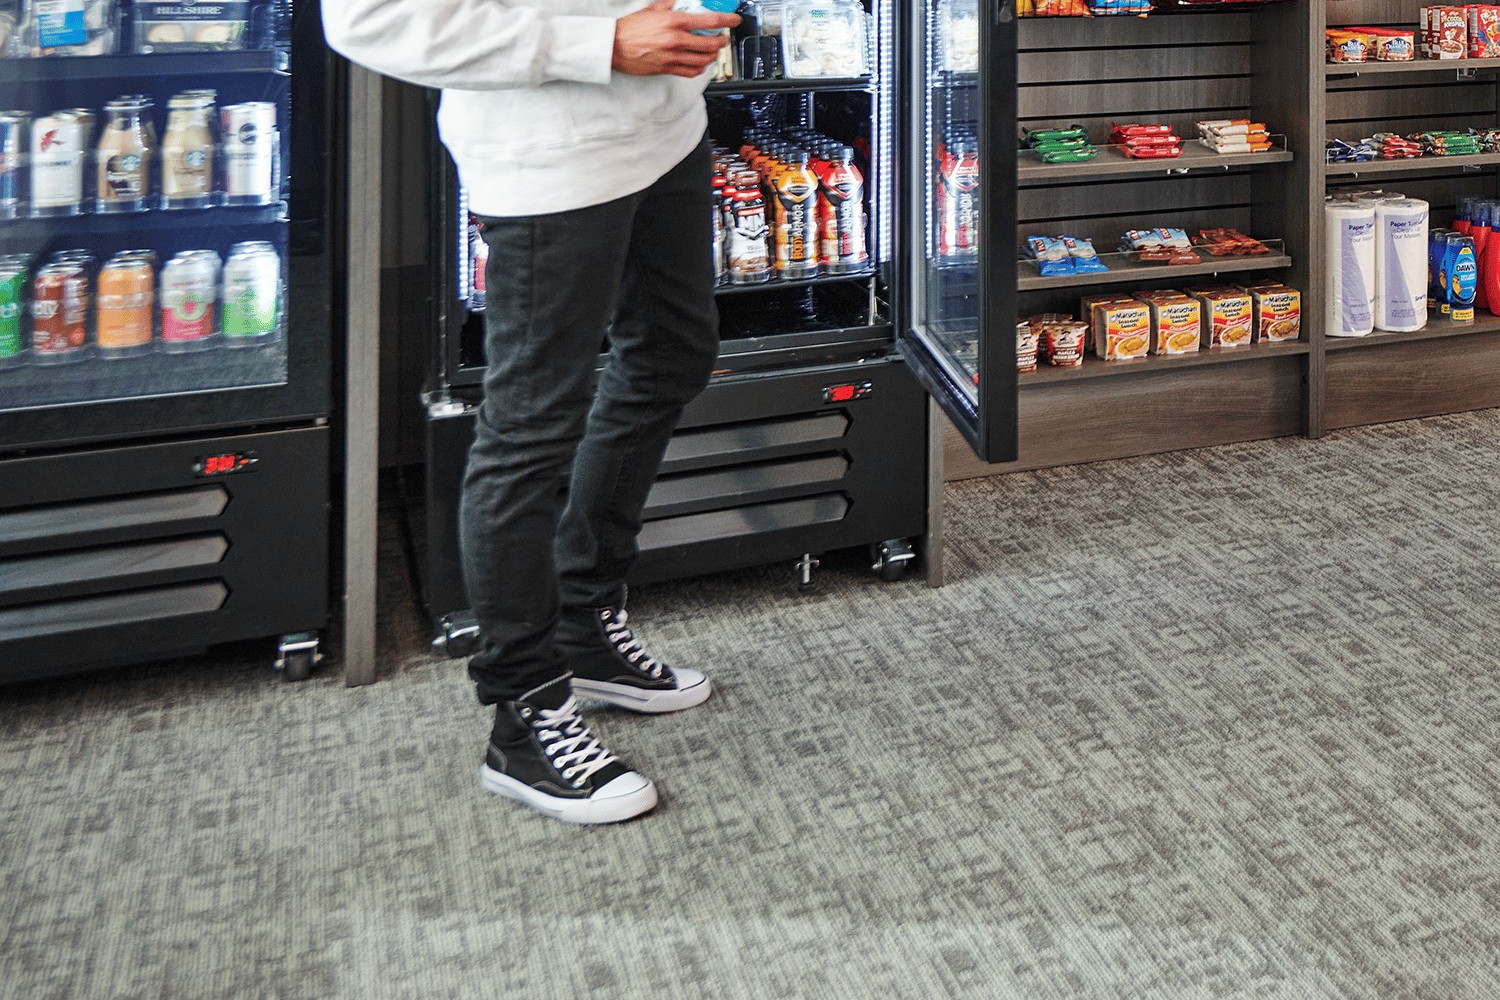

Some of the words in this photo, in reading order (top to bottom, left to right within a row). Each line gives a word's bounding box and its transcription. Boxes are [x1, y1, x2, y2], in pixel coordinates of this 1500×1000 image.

[155, 5, 223, 15] HILLSHIRE
[1390, 220, 1407, 228] Paper
[1455, 263, 1475, 272] DAWN
[1268, 295, 1298, 303] Maruchan
[1220, 300, 1250, 308] Maruchan
[1168, 306, 1198, 314] Maruchan
[1115, 310, 1147, 319] Maruchan
